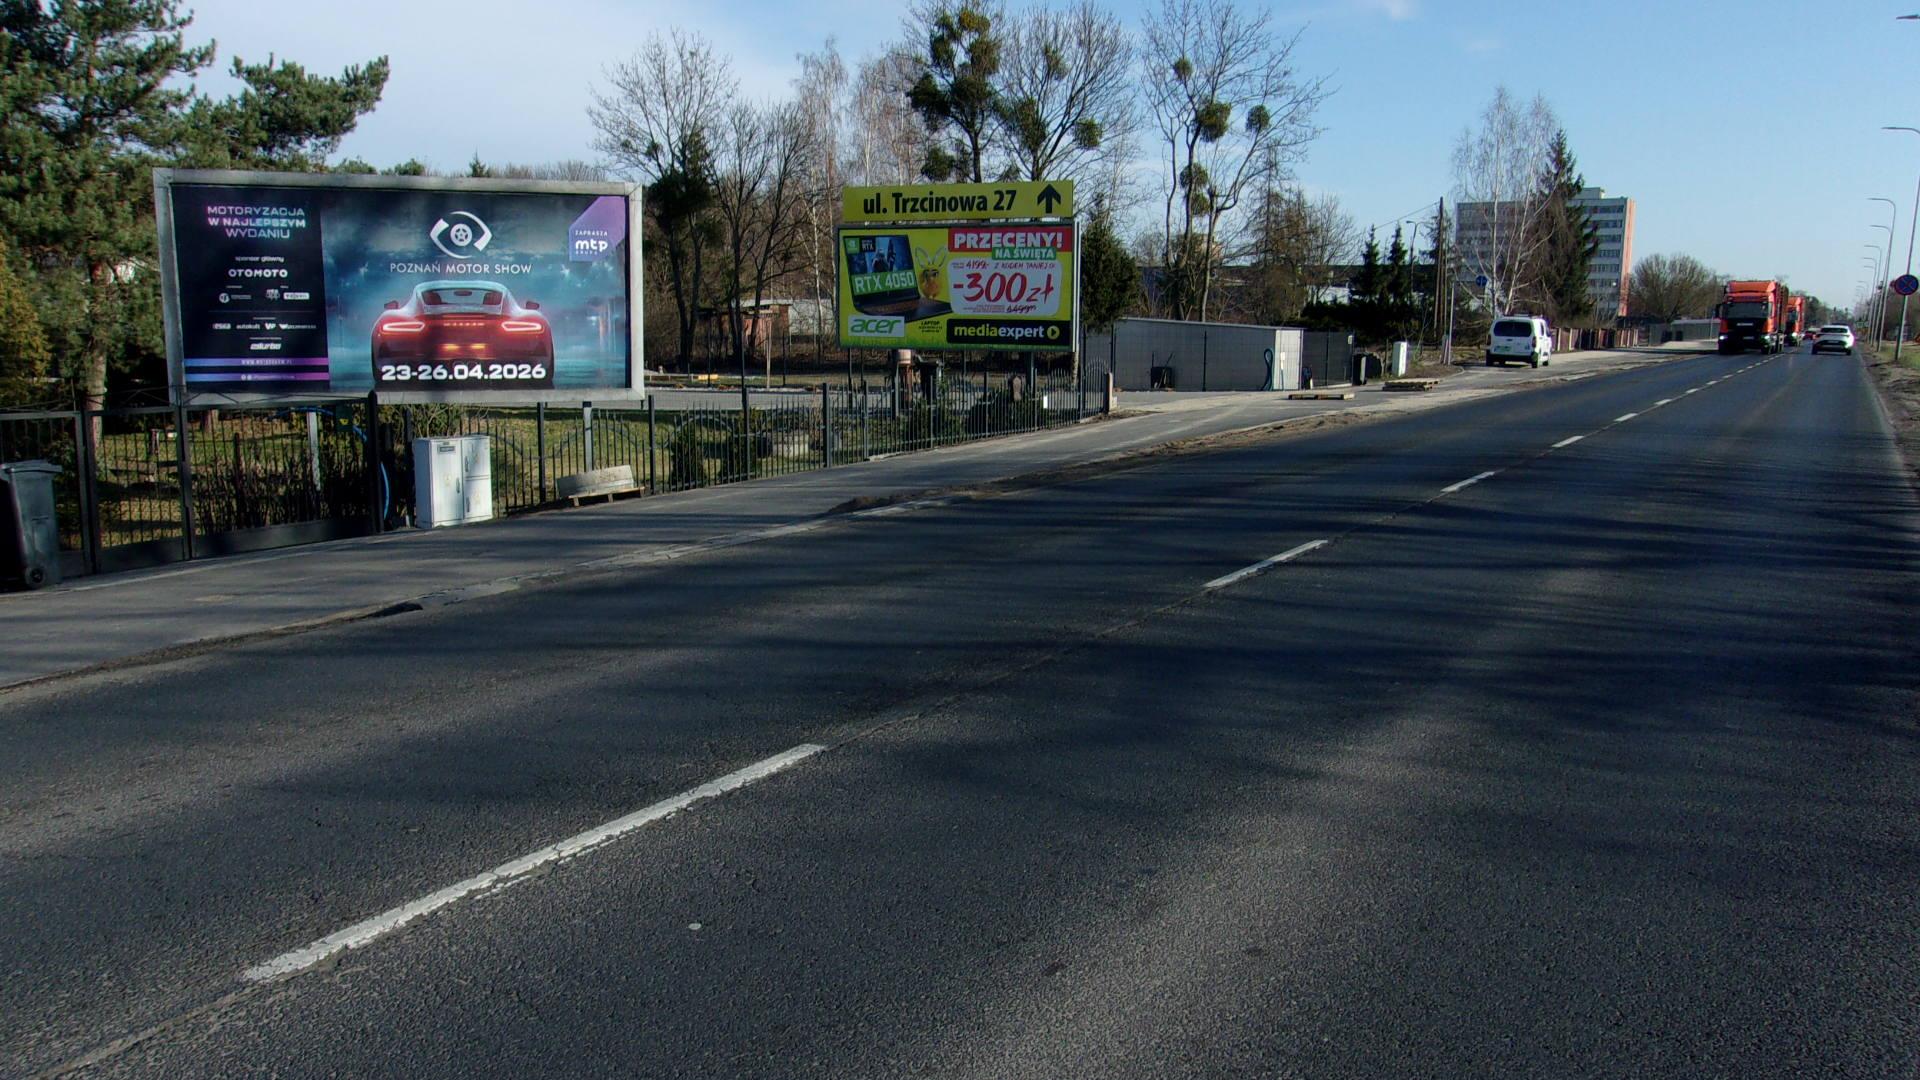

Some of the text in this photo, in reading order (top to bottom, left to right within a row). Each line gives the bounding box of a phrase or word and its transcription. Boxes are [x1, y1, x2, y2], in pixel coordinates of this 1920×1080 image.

[863, 190, 1017, 214] ul. Trzcinowa 27
[207, 206, 305, 216] MOTORYZACJA
[208, 217, 306, 228] W NAJLEPSZYM
[225, 228, 290, 239] WYDANIU
[954, 232, 1063, 249] PRZECENY!
[575, 239, 608, 253] mtp
[995, 248, 1054, 260] NA ŚWIĘTA
[228, 269, 288, 278] OTOMOTO
[390, 260, 532, 274] POZNAŃ MOTOR SHOW
[854, 271, 914, 292] RTX 4050
[851, 318, 902, 334] acer
[954, 323, 1045, 340] mediaexpert
[381, 364, 546, 381] 23-26.04.2026
